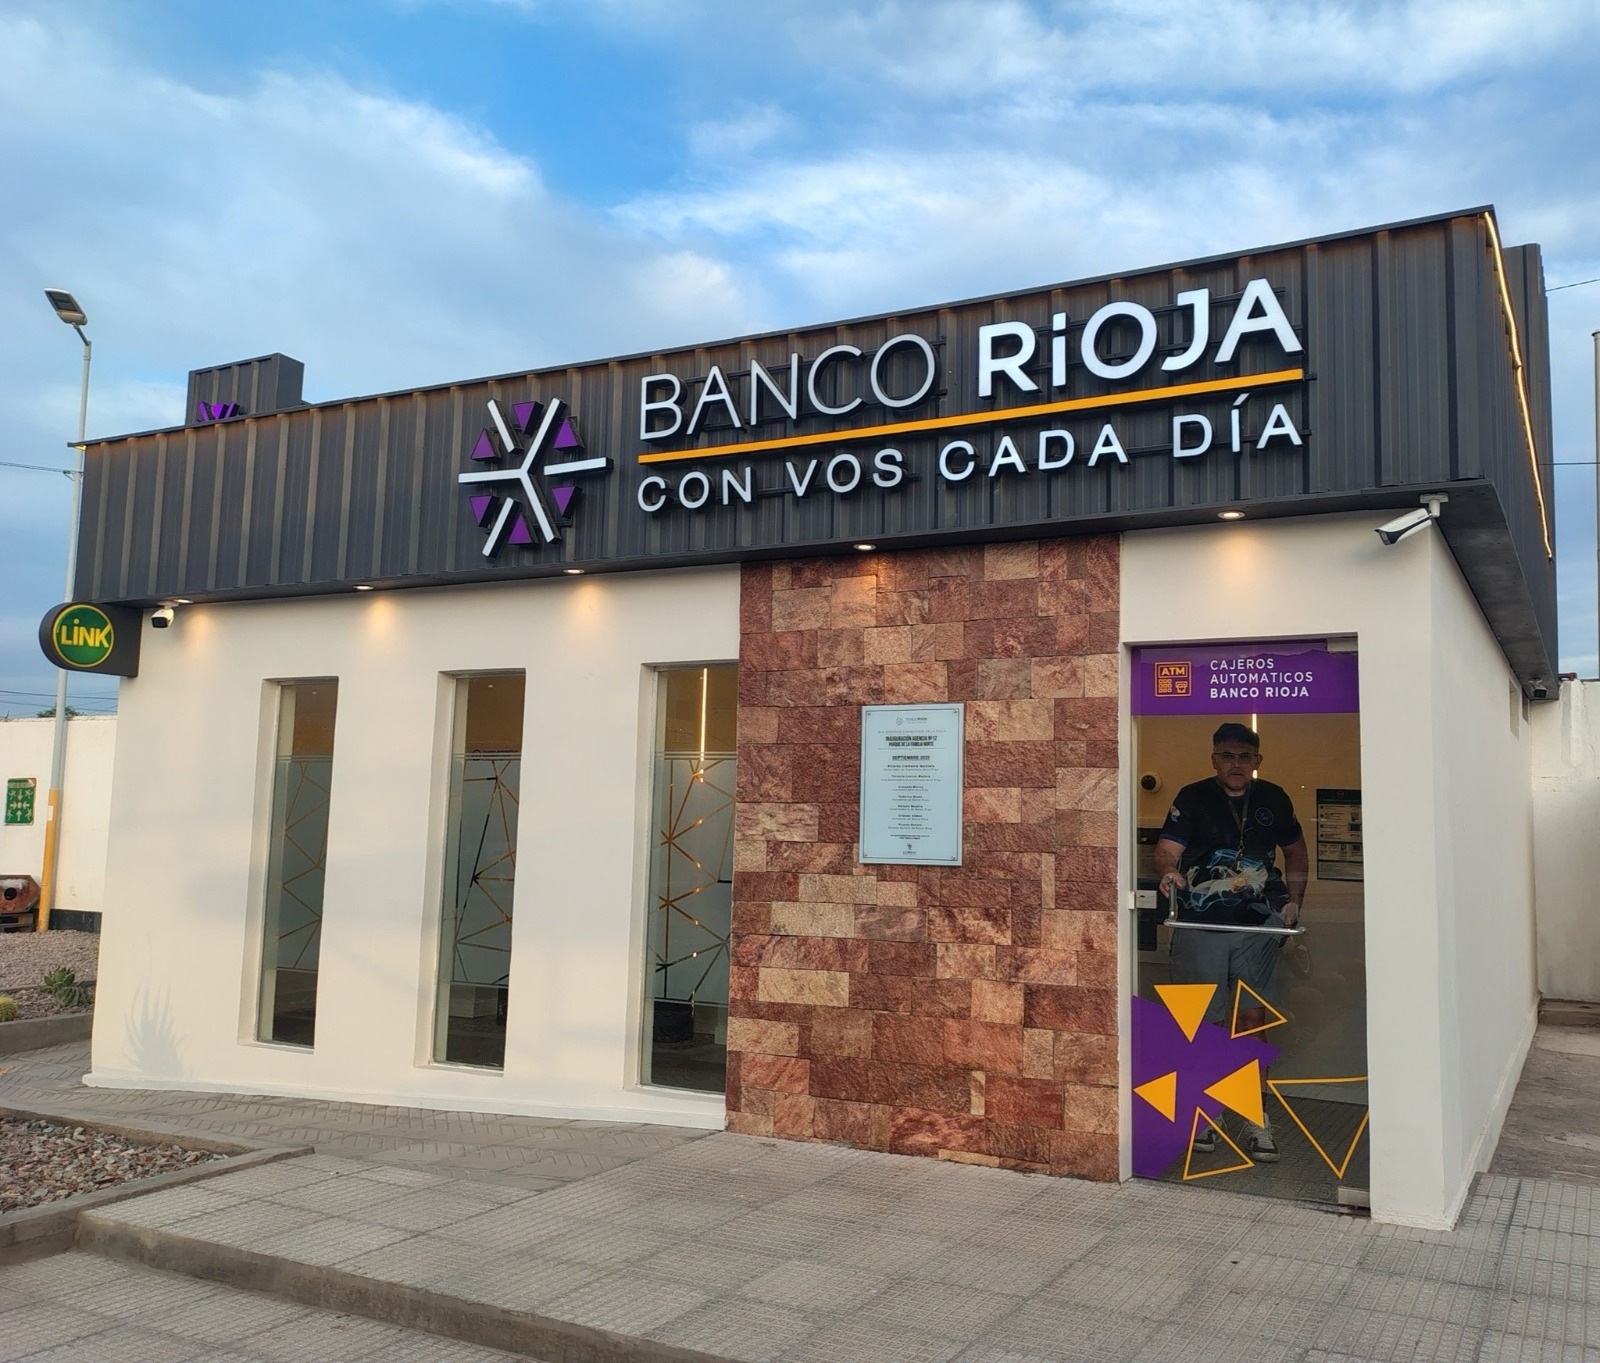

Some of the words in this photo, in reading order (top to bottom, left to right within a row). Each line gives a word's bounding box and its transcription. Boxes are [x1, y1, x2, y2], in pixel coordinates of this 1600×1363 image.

[639, 333, 937, 441] BANCO
[637, 466, 753, 513] CON
[785, 448, 904, 497] VOS
[938, 423, 1130, 482] CADA
[1172, 392, 1304, 459] DÍA
[1161, 666, 1186, 676] ATM
[1209, 658, 1275, 671] CAJEROS
[1209, 671, 1314, 685] AUTOMATICOS
[1209, 687, 1260, 699] BANCO
[1265, 686, 1310, 698] RIOJA
